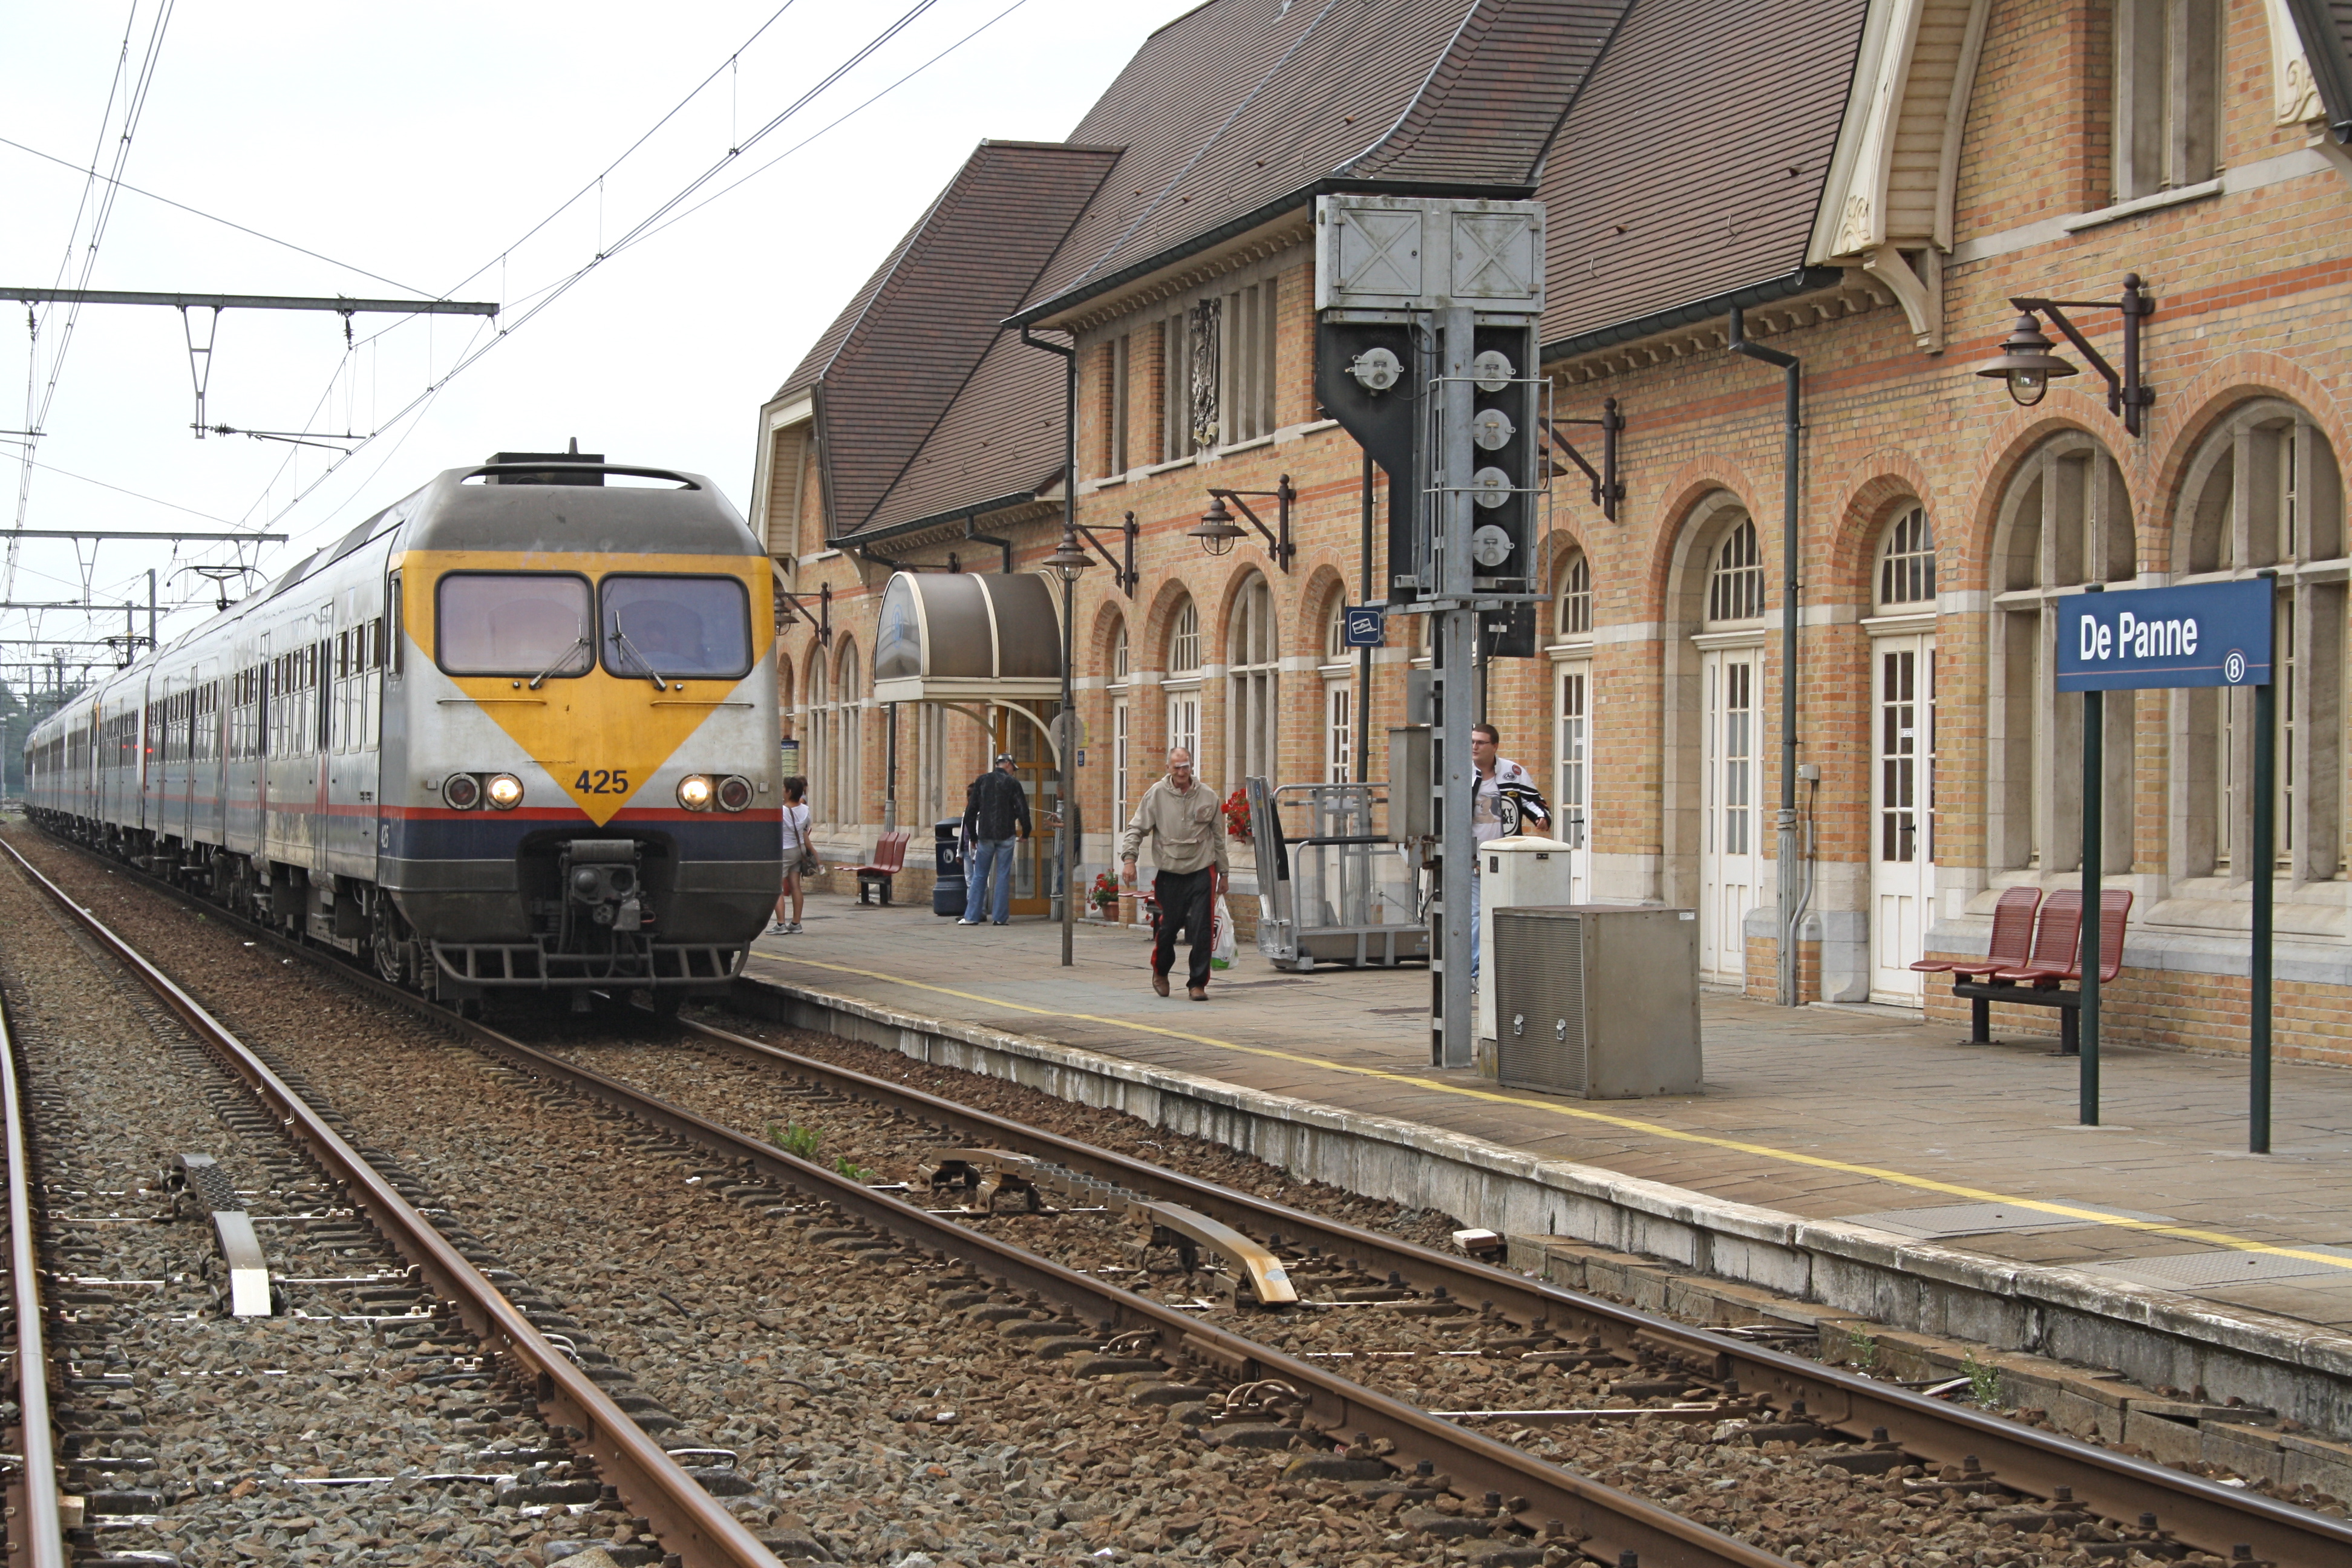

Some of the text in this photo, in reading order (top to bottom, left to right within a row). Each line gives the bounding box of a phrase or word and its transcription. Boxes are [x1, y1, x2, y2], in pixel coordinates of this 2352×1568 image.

[2080, 612, 2198, 661] De Panne
[575, 769, 629, 794] 425
[381, 824, 389, 849] 425
